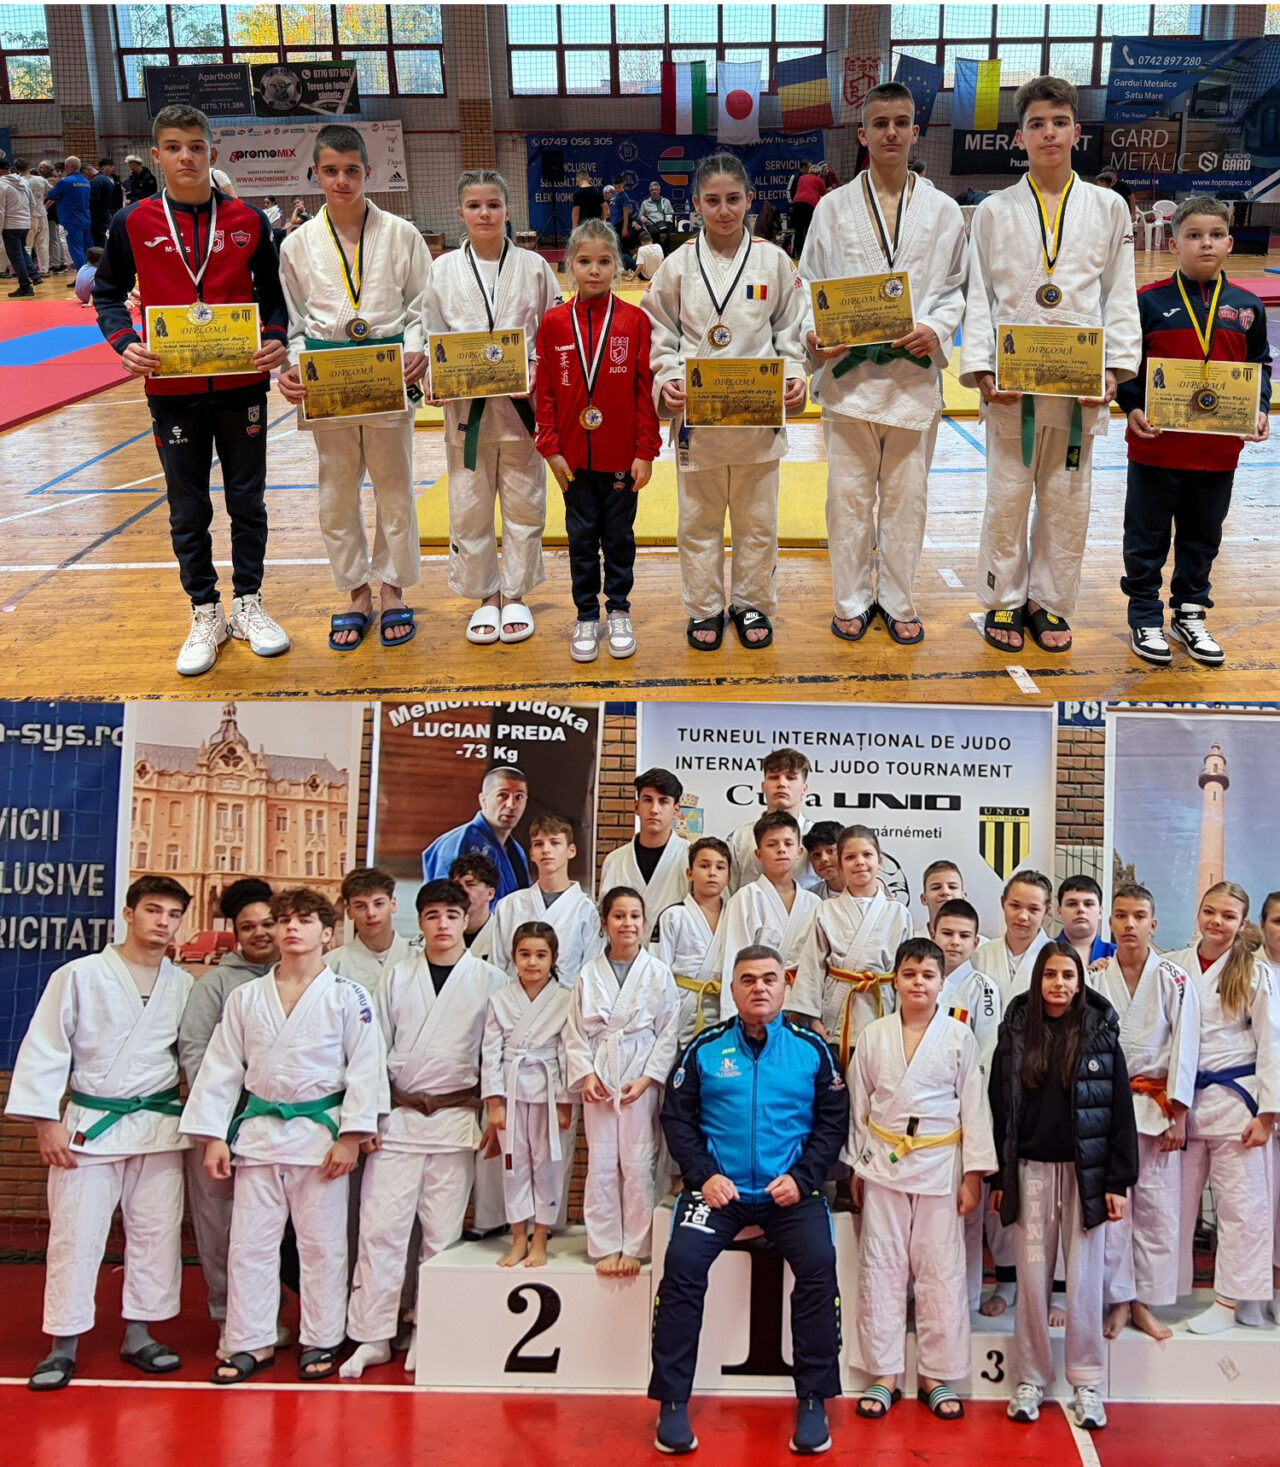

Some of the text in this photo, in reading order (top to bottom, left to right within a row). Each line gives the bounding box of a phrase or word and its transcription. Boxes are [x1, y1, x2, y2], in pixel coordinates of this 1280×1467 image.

[1138, 55, 1201, 66] 0742 897 280
[848, 63, 879, 72] CSM
[198, 72, 241, 83] Aparthotel
[1113, 78, 1177, 88] Garduri Metalice
[1125, 91, 1164, 100] Satu Mare
[541, 137, 613, 147] 0749 056 305
[1110, 128, 1169, 148] GARD
[236, 148, 297, 161] promoMIX
[1110, 151, 1191, 172] METALIC
[1222, 158, 1251, 171] GARD
[754, 175, 768, 185] ALL
[1192, 178, 1252, 187] www.toptrapez.ro
[609, 366, 628, 374] JUDO
[412, 722, 566, 741] LUCIAN PREDA
[677, 728, 1012, 751] TURNEUL INTERNAȚIONAL DE JUDO
[455, 743, 518, 763] -73 Kg
[829, 760, 880, 775] JUDO
[886, 760, 1013, 778] TOURNAMENT
[833, 791, 961, 811] UNIO
[983, 807, 1026, 816] UNIO
[870, 823, 943, 839] márnémeti
[504, 1282, 562, 1373] 2
[980, 1349, 1005, 1383] 3
